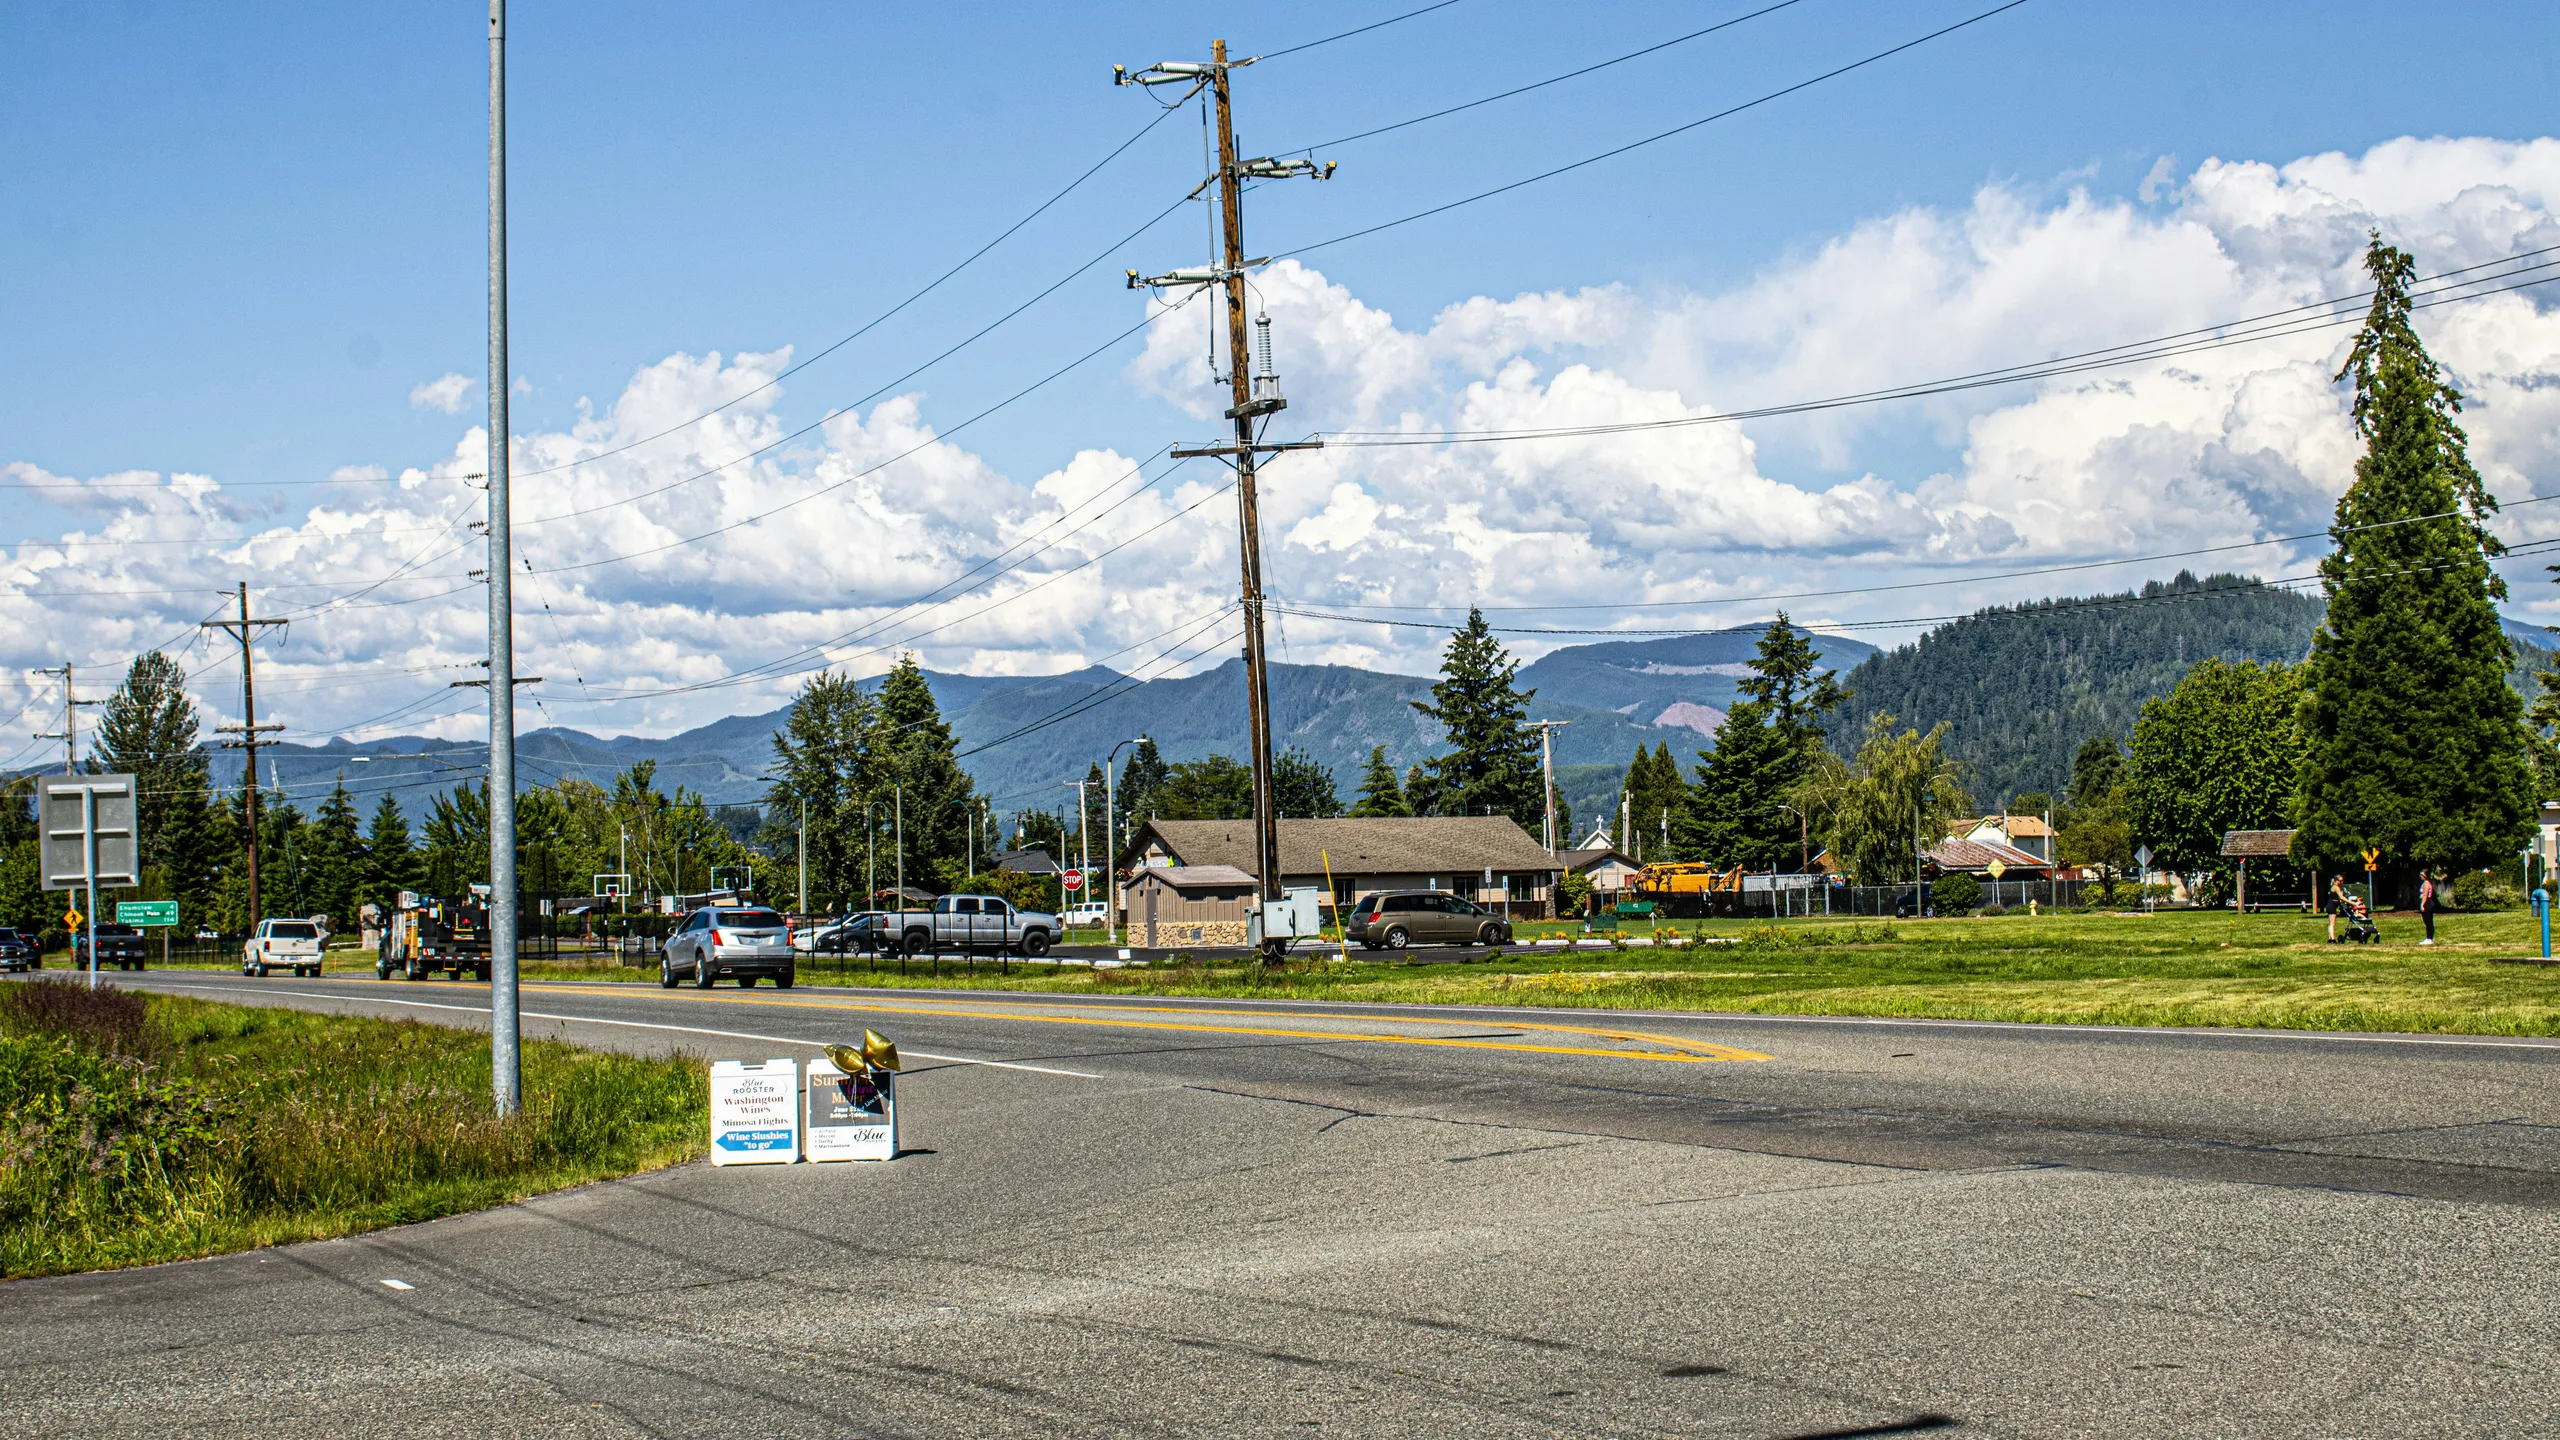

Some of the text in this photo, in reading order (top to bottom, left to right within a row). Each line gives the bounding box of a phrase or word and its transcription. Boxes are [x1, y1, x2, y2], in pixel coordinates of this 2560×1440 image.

[1064, 875, 1082, 884] STOP
[742, 1078, 764, 1087] Blue
[733, 1086, 775, 1095] ROOSTER
[724, 1095, 784, 1105] Washington
[740, 1106, 771, 1114] Wines
[722, 1117, 789, 1127] Mimosa Flights
[726, 1131, 789, 1141] Wine Slushies
[853, 1127, 887, 1142] Blue
